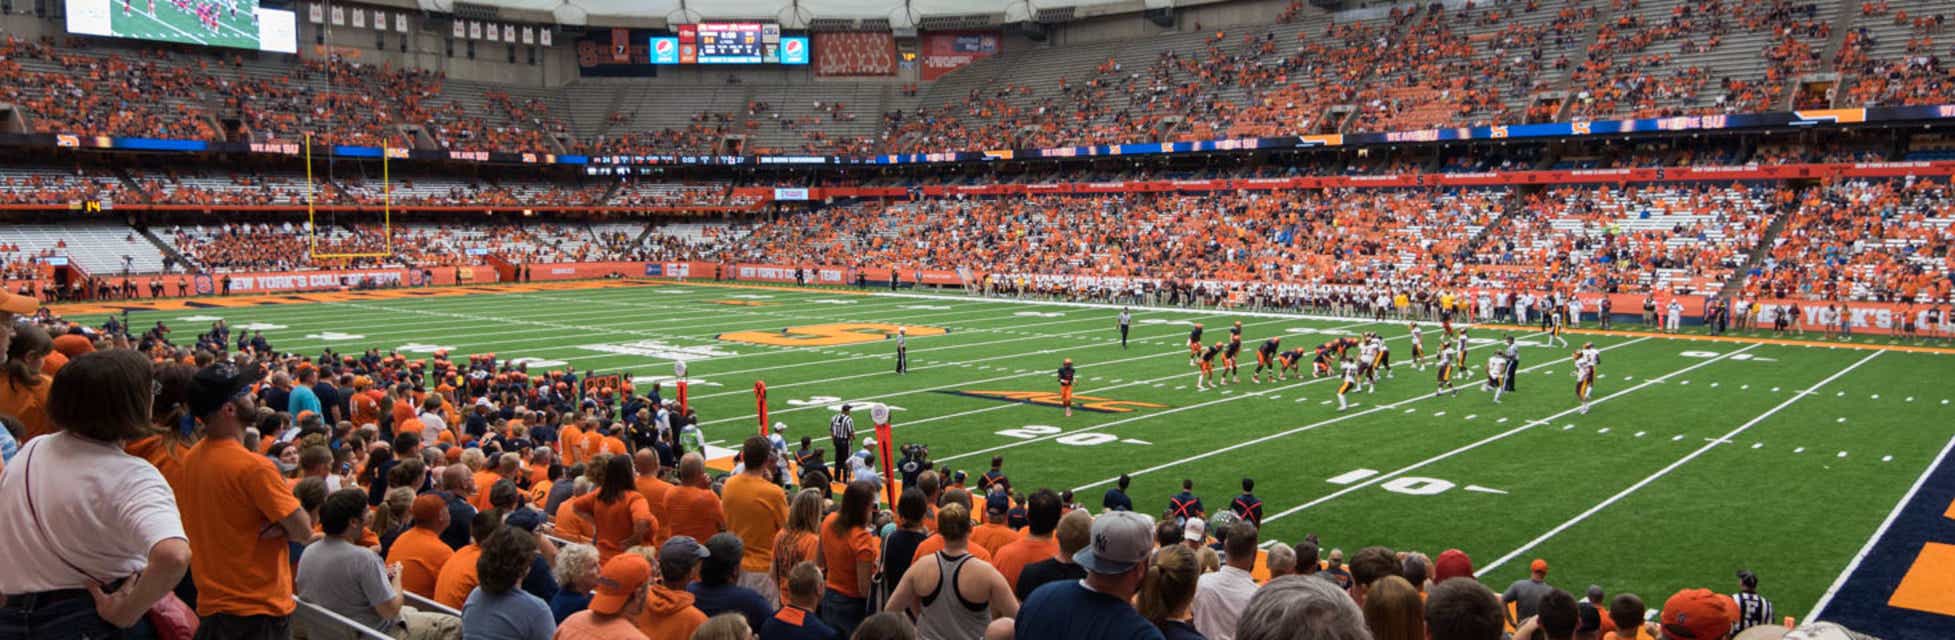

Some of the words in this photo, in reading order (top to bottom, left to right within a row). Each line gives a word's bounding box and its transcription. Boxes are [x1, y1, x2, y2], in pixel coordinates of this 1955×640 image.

[86, 200, 101, 212] 14
[257, 276, 307, 290] YORK'S
[1804, 307, 1892, 328] YOK'S
[994, 425, 1118, 445] 20
[1326, 468, 1456, 495] 10
